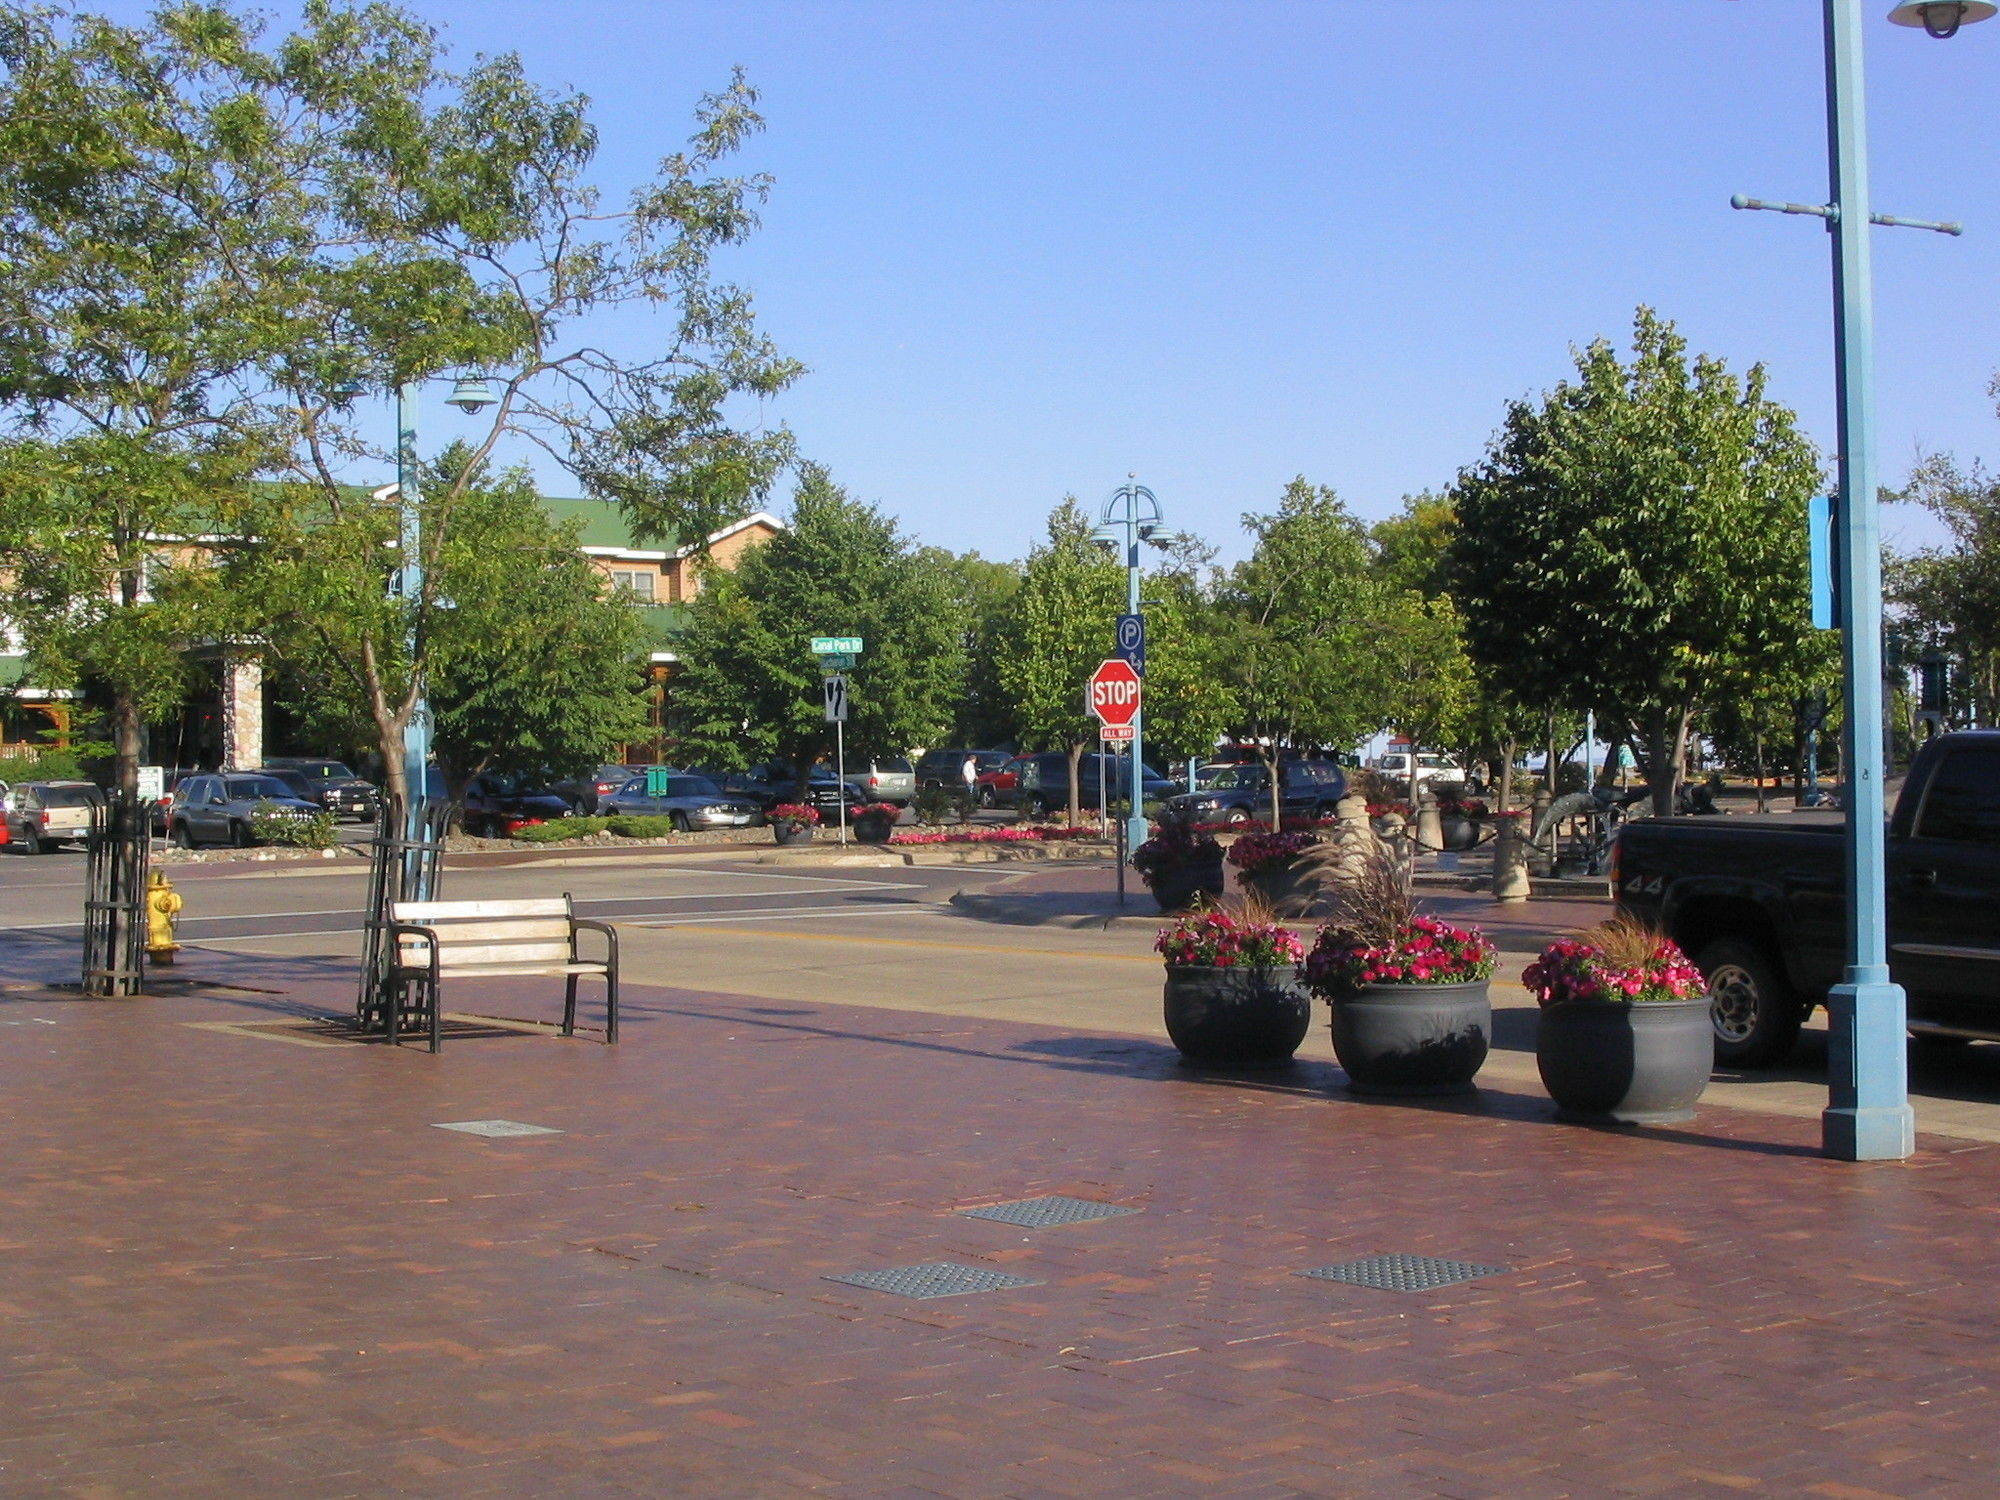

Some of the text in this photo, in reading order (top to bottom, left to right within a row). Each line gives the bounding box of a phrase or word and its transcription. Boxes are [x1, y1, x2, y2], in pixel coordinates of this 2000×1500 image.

[1126, 623, 1137, 644] P
[834, 640, 850, 650] Park
[1095, 680, 1137, 706] STOP
[1104, 729, 1132, 737] ALL WAY
